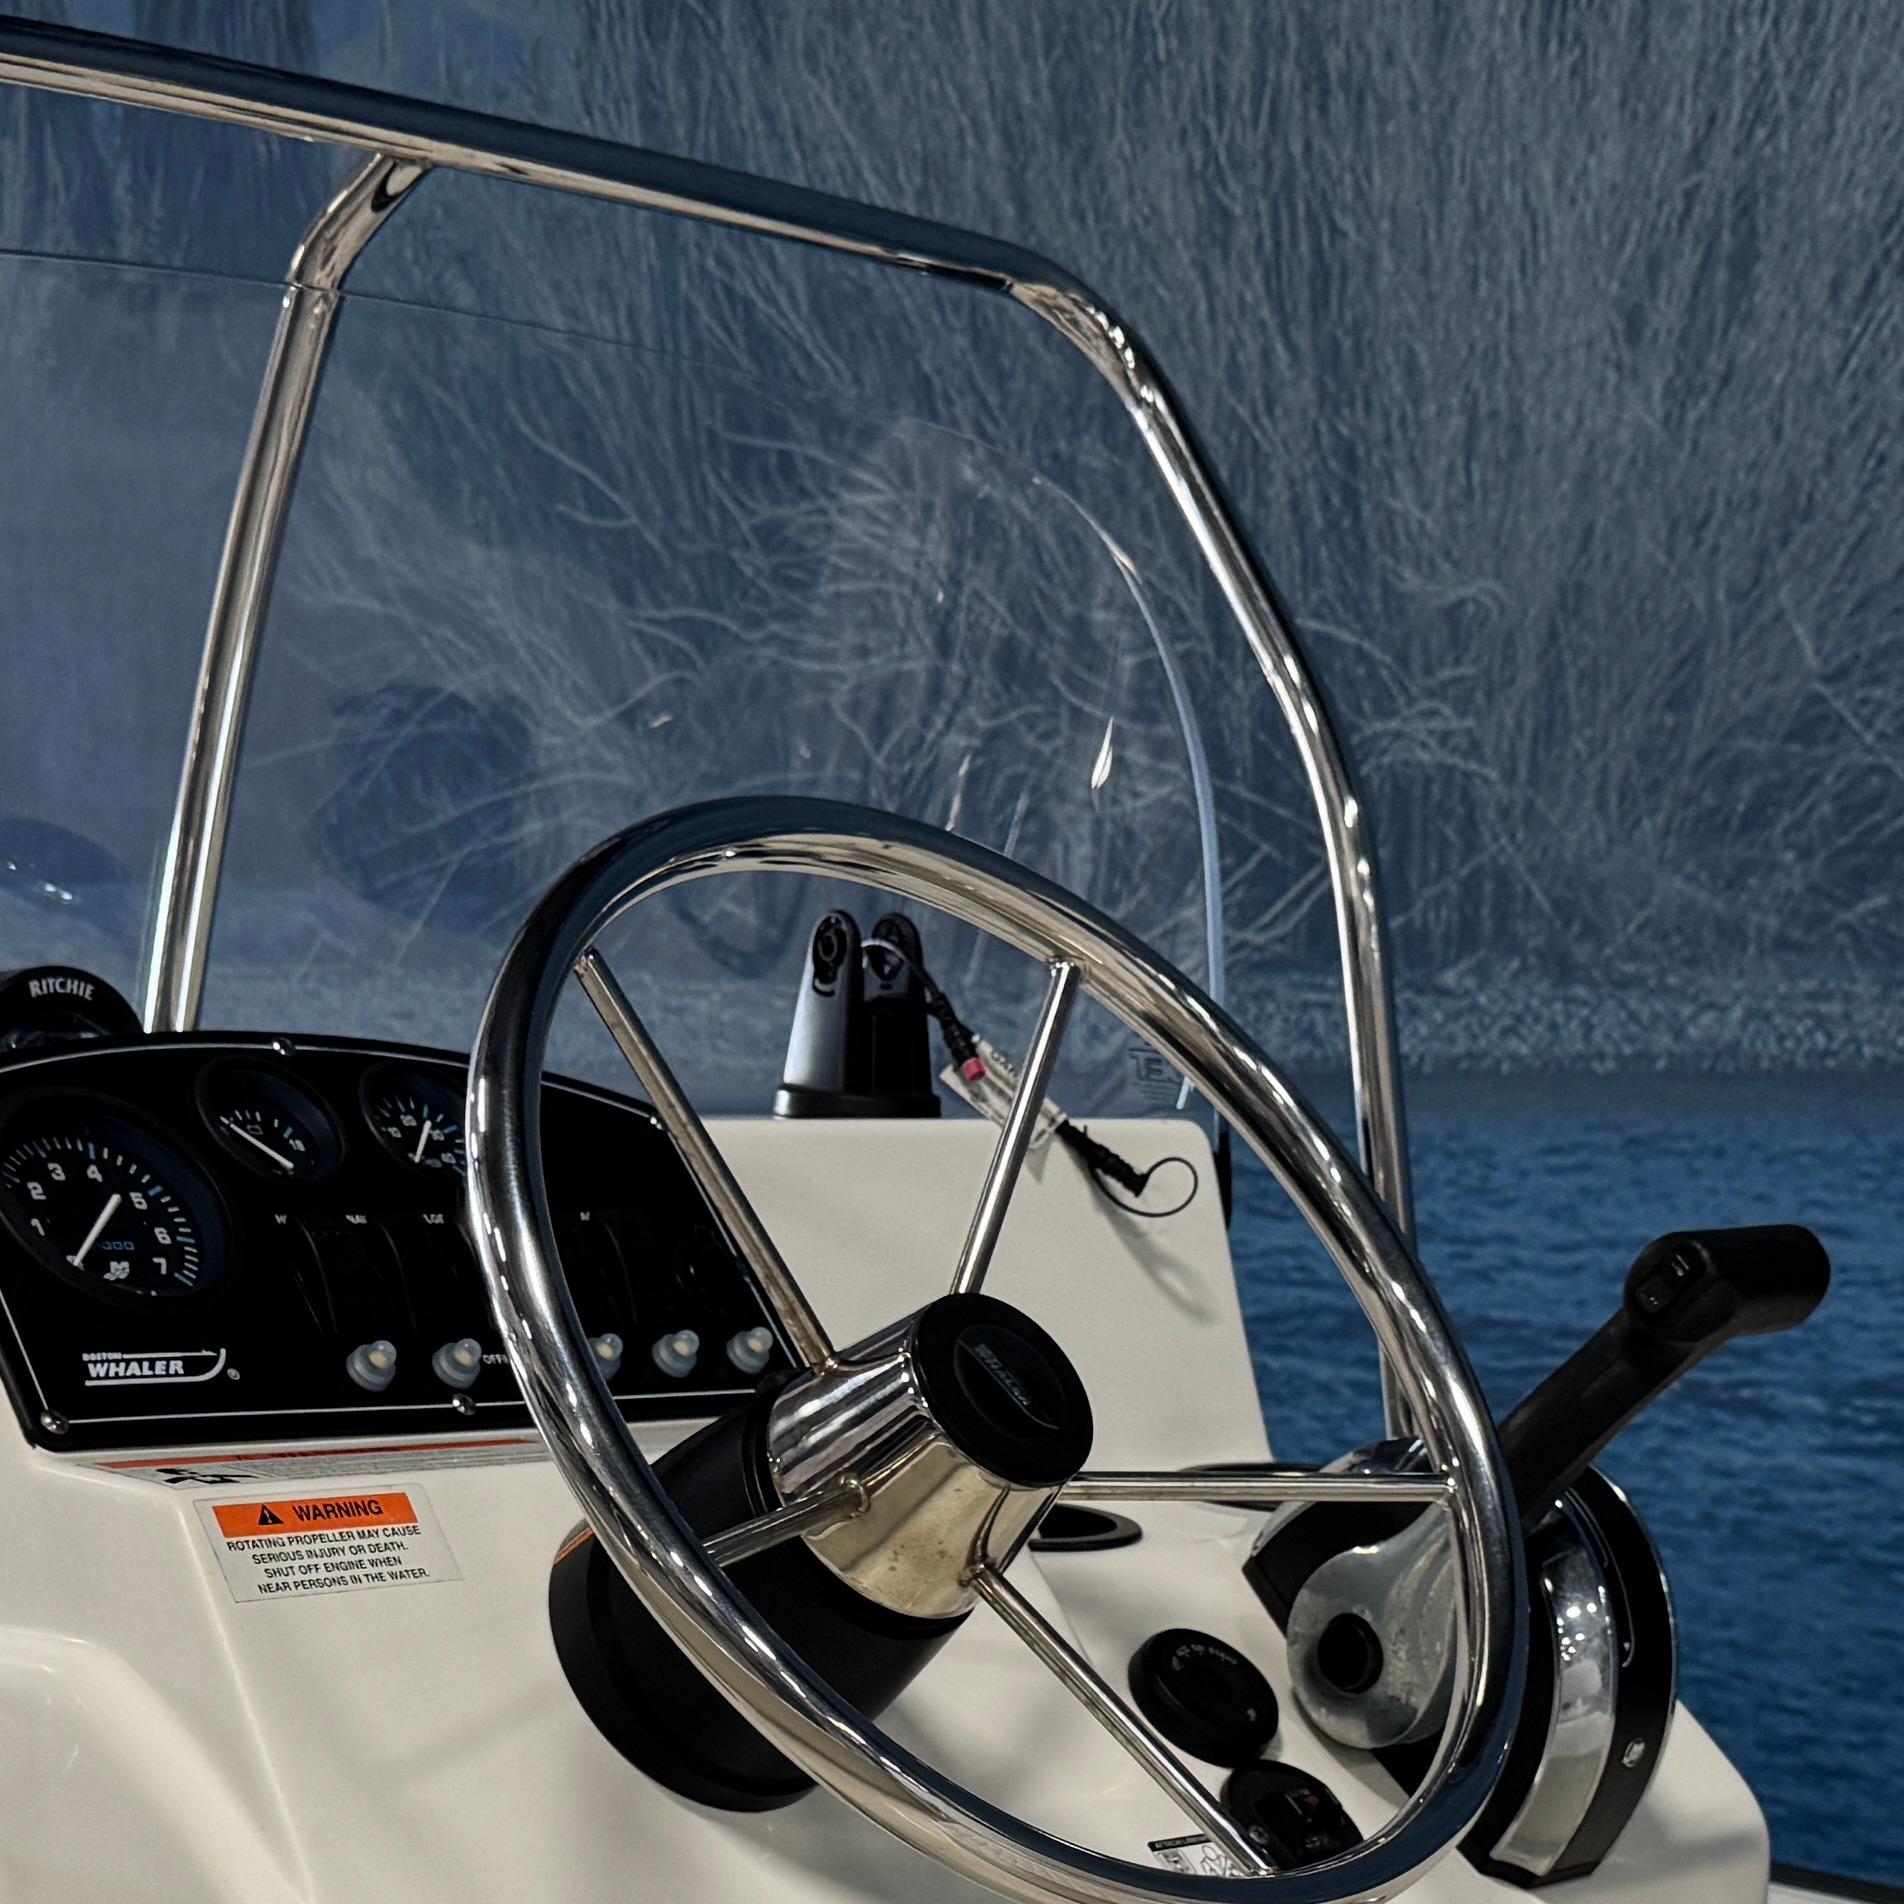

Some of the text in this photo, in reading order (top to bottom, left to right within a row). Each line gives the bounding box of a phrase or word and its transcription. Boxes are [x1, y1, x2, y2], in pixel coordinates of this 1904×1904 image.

[28, 976, 96, 1001] RITCHIE
[47, 1162, 66, 1181] 3
[86, 1164, 103, 1183] 4
[26, 1181, 47, 1200] 2
[129, 1191, 147, 1210] 5
[154, 1227, 172, 1245] 6
[152, 1257, 167, 1275] 7
[82, 1353, 122, 1361] BOSTON
[87, 1360, 185, 1377] WHALER
[292, 1499, 384, 1522] WARNING
[227, 1525, 421, 1552] ROTATING PROPELLER MAY CAUSE
[252, 1541, 408, 1565] SERIOUS INJURY OR DEATH.
[264, 1556, 402, 1579] SHUT OFF ENGINE WHEN
[258, 1567, 430, 1595] NEAR PERSONS IN THE WATER.
